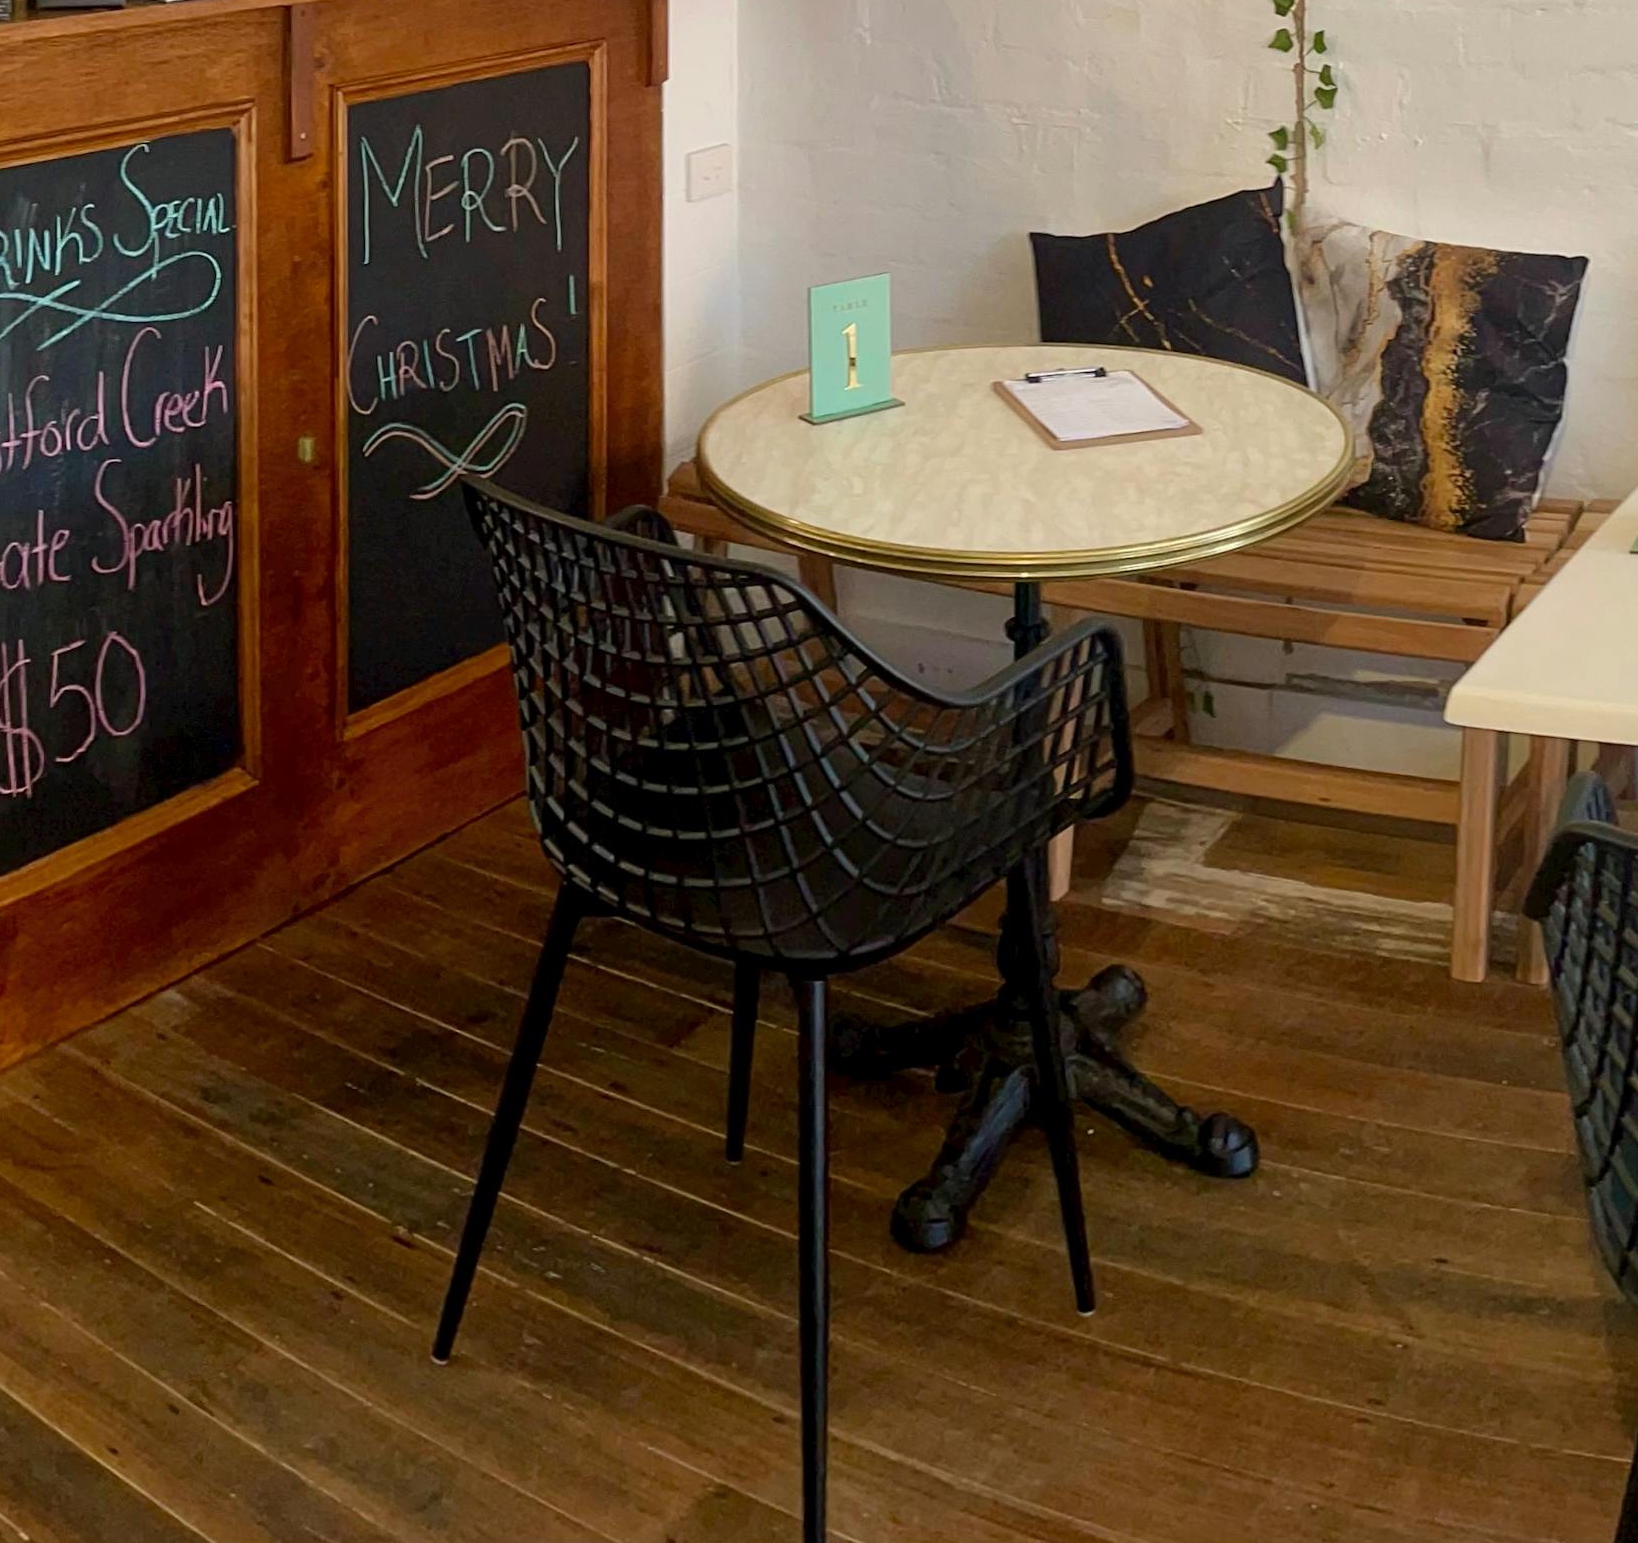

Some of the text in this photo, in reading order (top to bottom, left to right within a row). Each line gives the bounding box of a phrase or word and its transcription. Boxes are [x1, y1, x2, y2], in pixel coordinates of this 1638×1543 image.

[112, 142, 231, 282] SPECIAL
[360, 123, 579, 266] MERRY
[122, 325, 229, 450] Creek
[841, 322, 864, 391] 1
[90, 458, 235, 607] Sparkling
